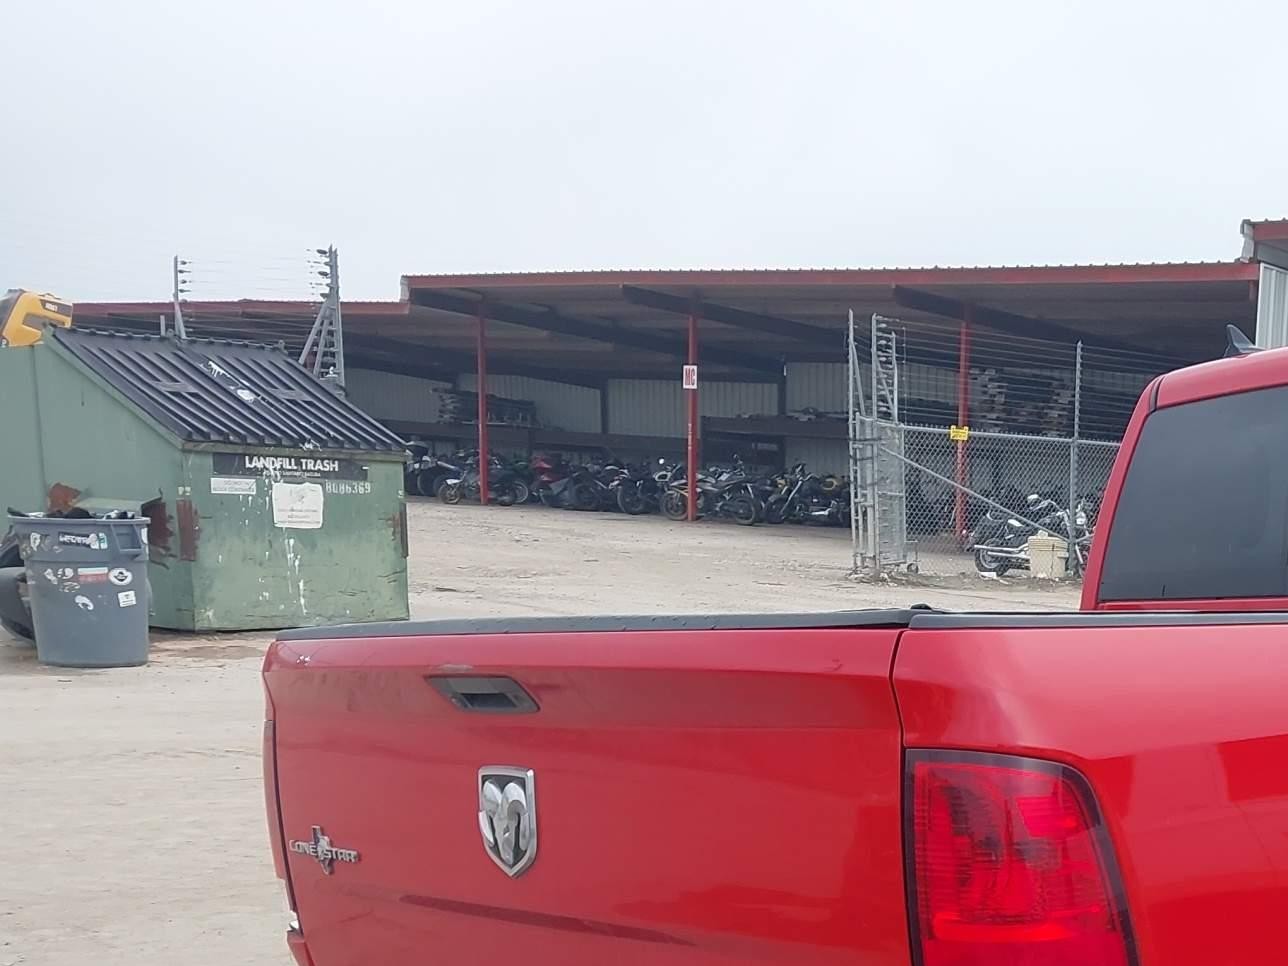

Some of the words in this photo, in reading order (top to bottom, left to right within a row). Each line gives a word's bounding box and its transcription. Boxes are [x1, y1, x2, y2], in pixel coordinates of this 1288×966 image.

[684, 367, 696, 386] MC
[245, 456, 297, 469] LANDFILL
[301, 459, 339, 472] TRASH
[289, 840, 317, 856] LONE
[321, 847, 358, 862] STAR
